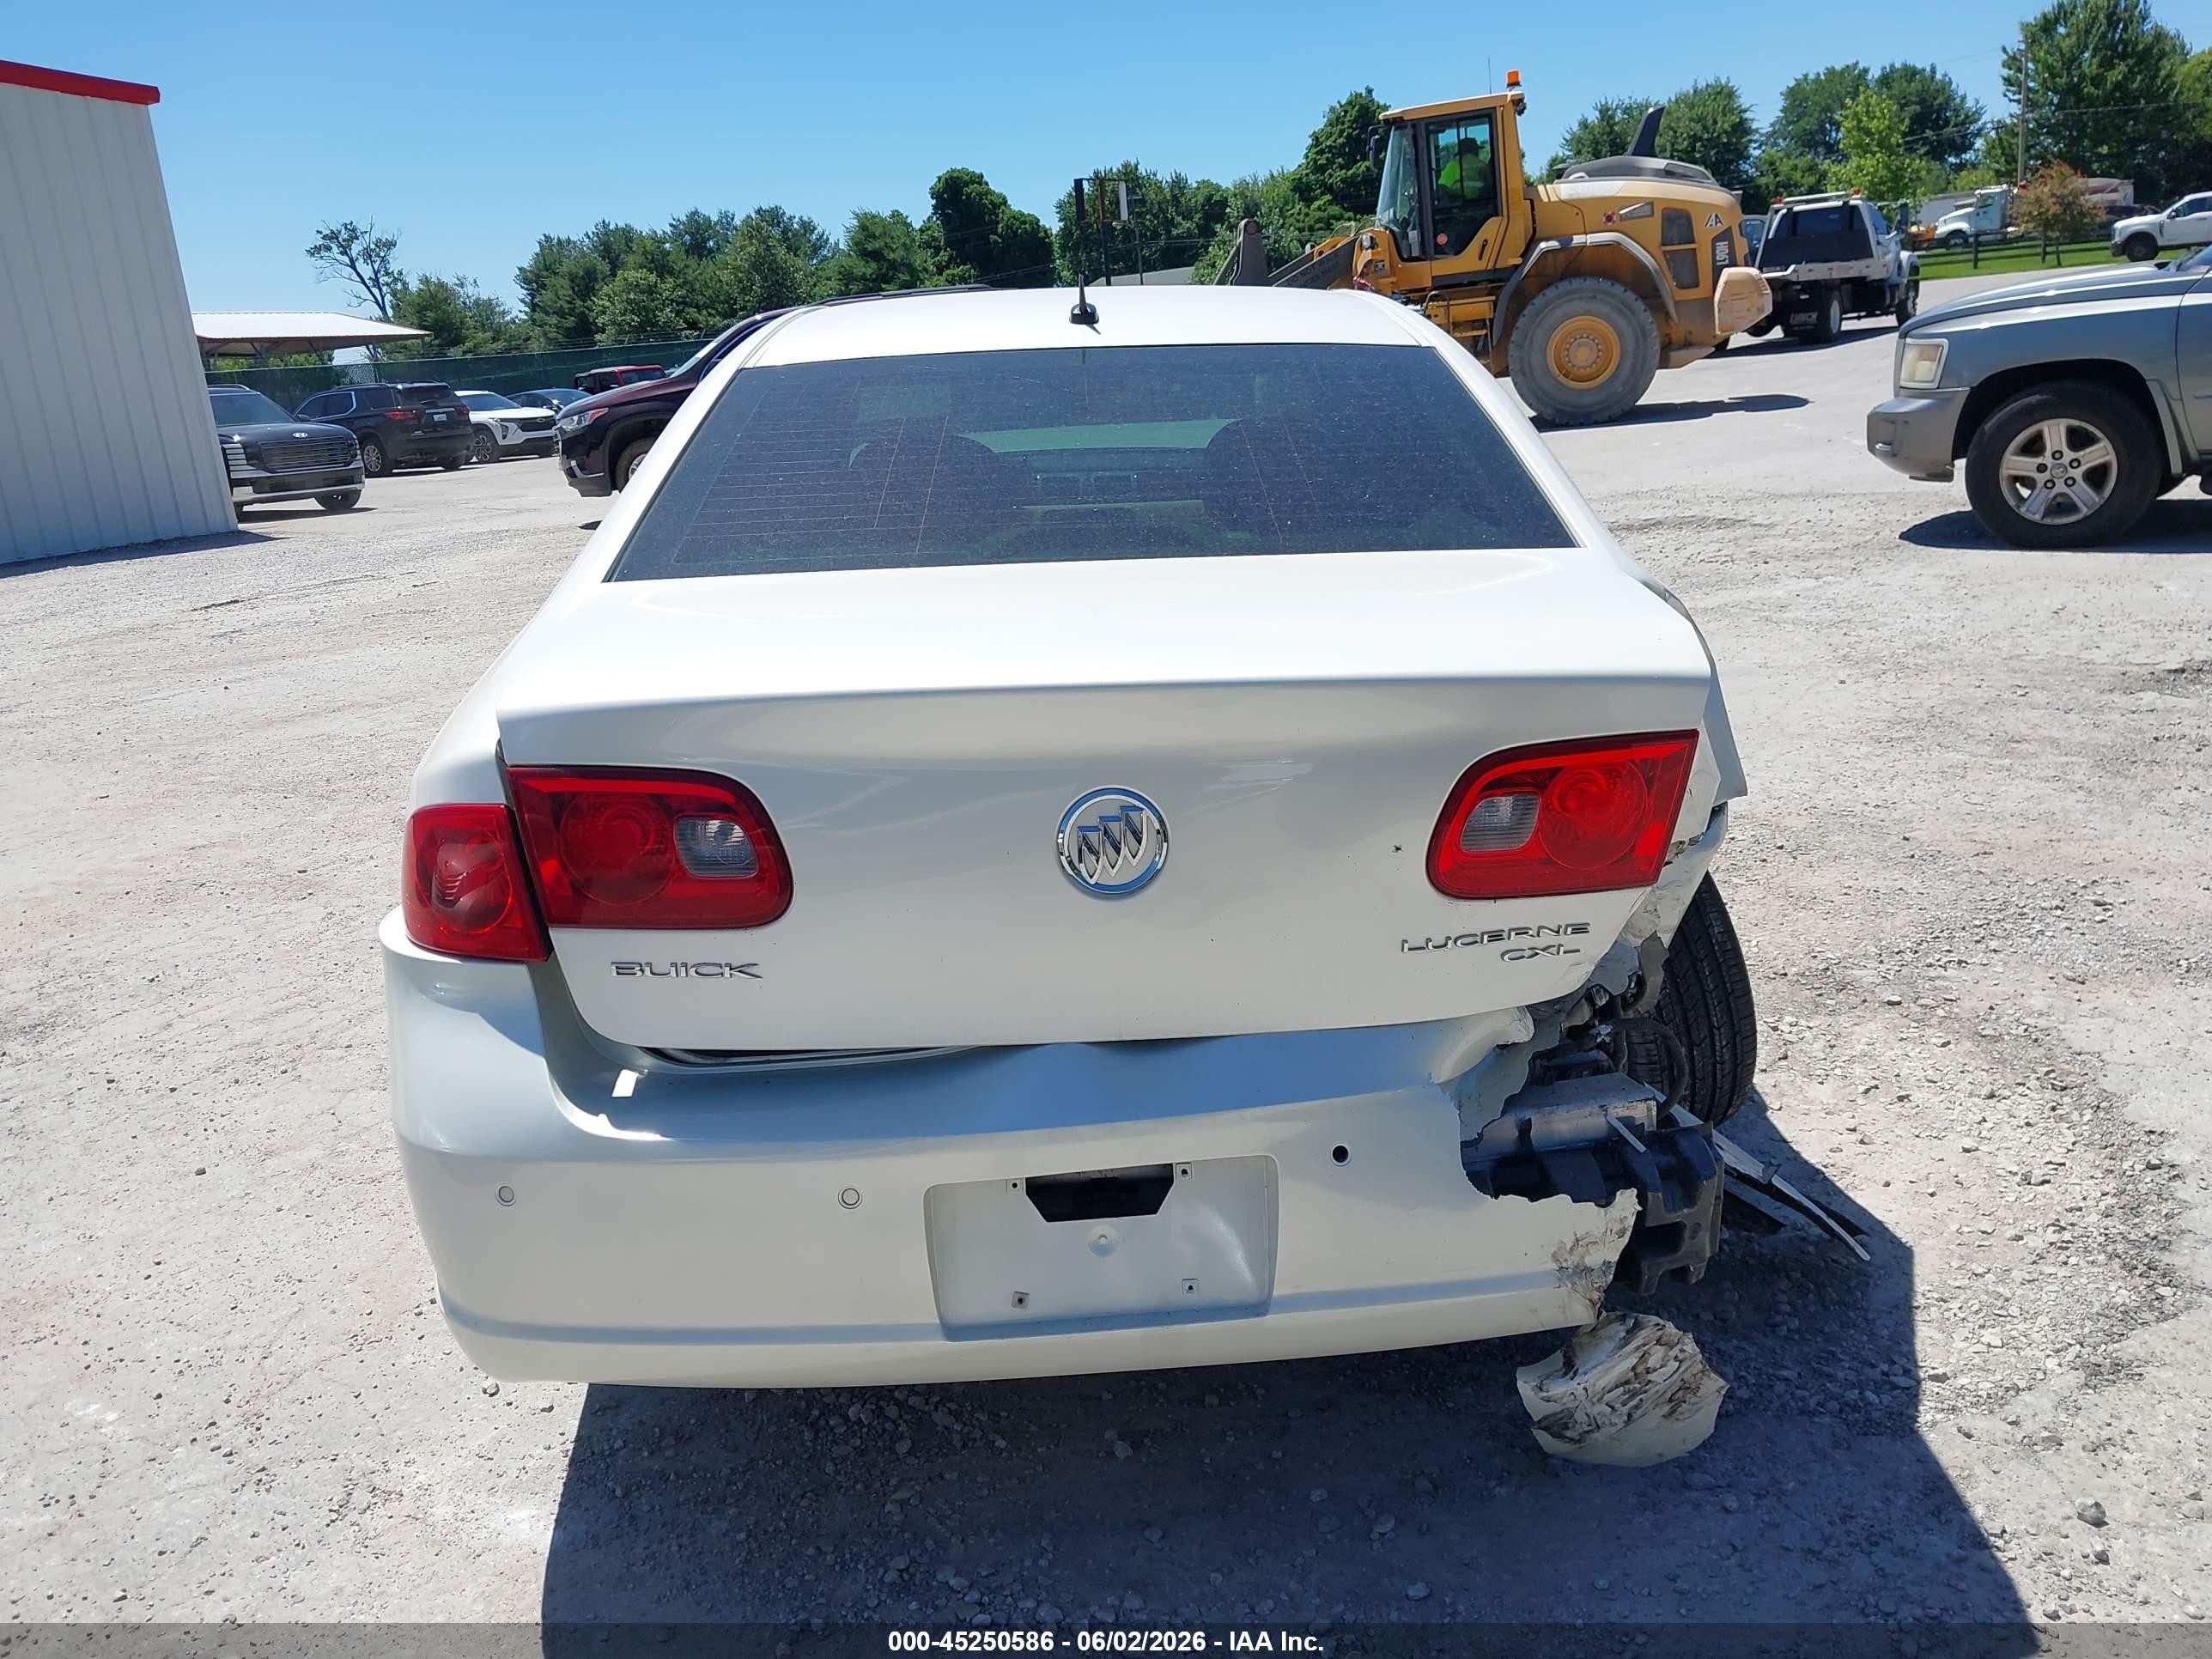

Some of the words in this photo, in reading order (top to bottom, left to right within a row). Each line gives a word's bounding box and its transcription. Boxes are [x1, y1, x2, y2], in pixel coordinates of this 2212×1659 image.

[1401, 922, 1590, 953] LUCERNE
[1500, 943, 1581, 963] CXL
[611, 962, 763, 979] BUICK
